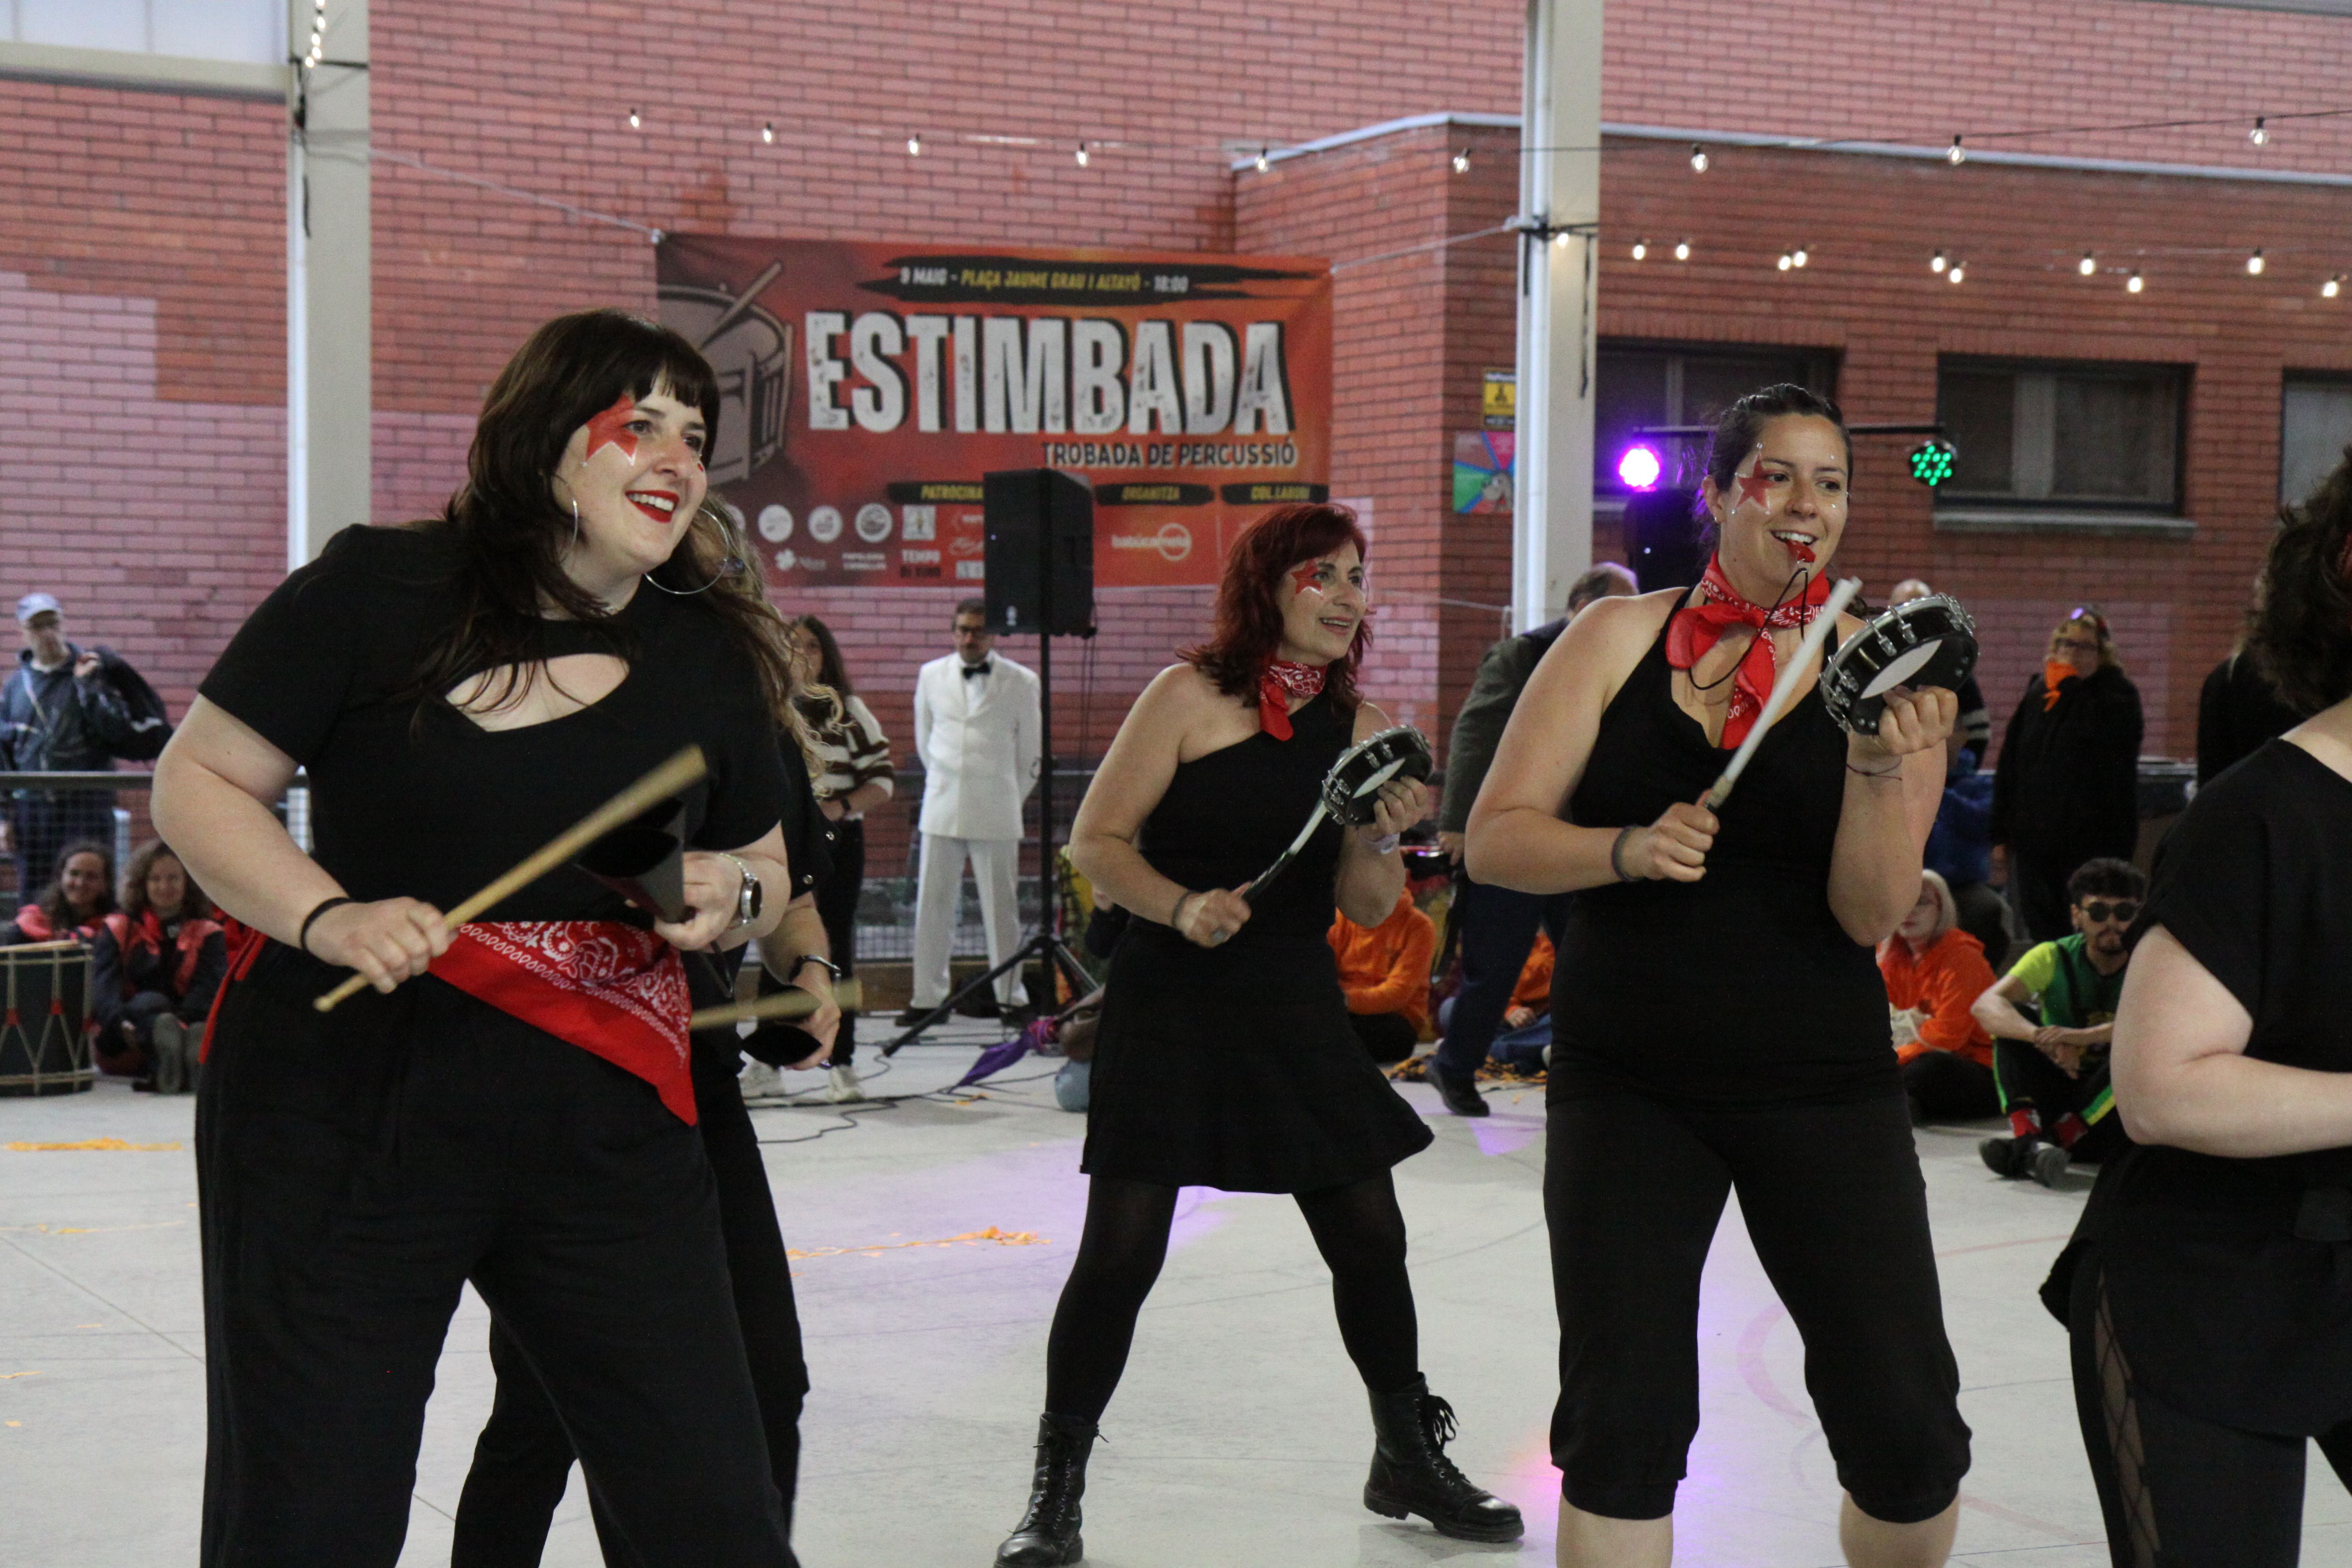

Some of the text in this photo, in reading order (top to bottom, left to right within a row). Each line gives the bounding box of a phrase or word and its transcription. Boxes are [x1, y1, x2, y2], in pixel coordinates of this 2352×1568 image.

[913, 268, 948, 286] MAIG
[960, 269, 1001, 292] PLAÇA
[1004, 270, 1048, 289] JAUME
[1050, 271, 1085, 290] GRAU
[805, 311, 1291, 435] ESTIMBADA
[1041, 439, 1297, 468] TROBADA DE PERCUSSIÓ
